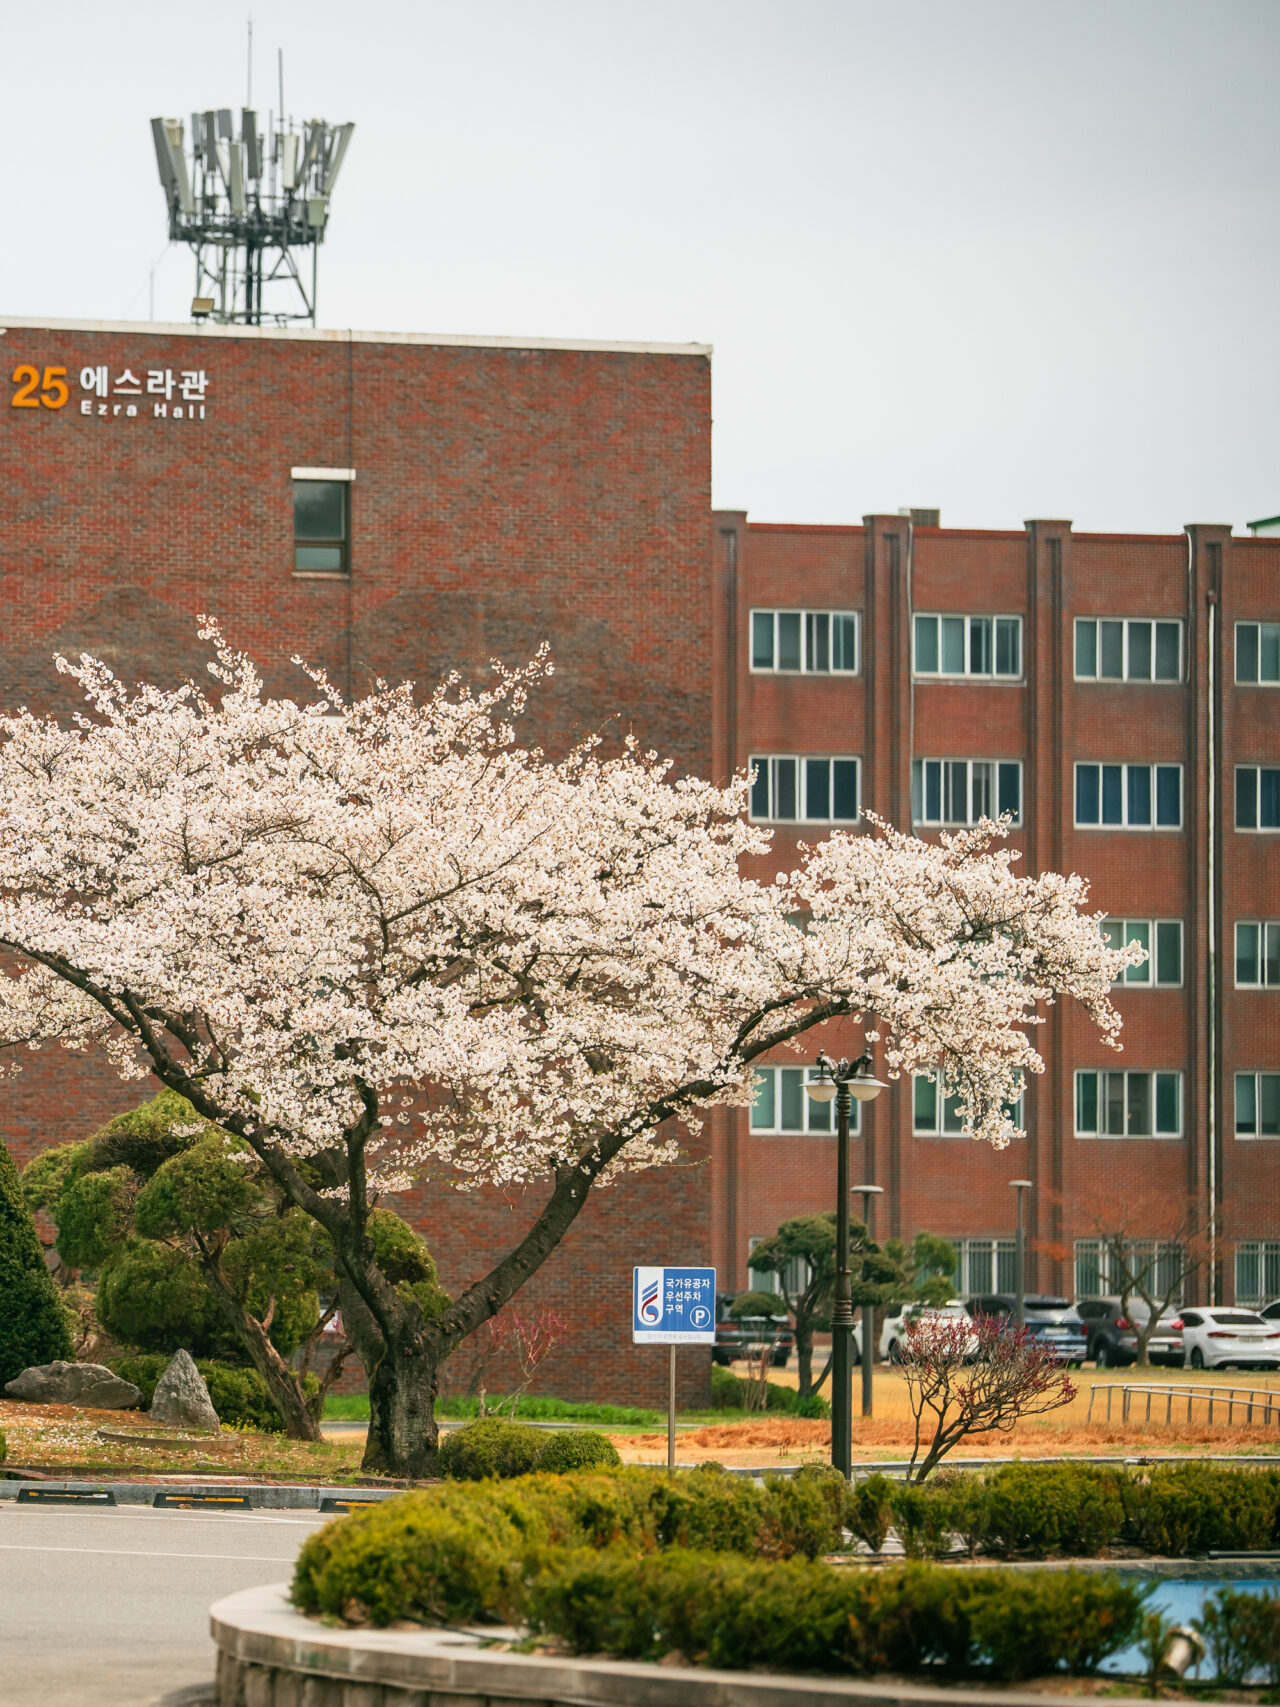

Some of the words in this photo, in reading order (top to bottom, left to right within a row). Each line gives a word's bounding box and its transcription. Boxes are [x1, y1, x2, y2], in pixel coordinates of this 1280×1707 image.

[11, 364, 69, 410] 25
[79, 365, 210, 401] 에스라관
[80, 400, 138, 418] Ezra
[154, 402, 206, 420] Hall
[665, 1278, 710, 1288] 국가유공자
[665, 1291, 701, 1301] 우선주차
[665, 1304, 684, 1314] 구역
[695, 1309, 706, 1323] P
